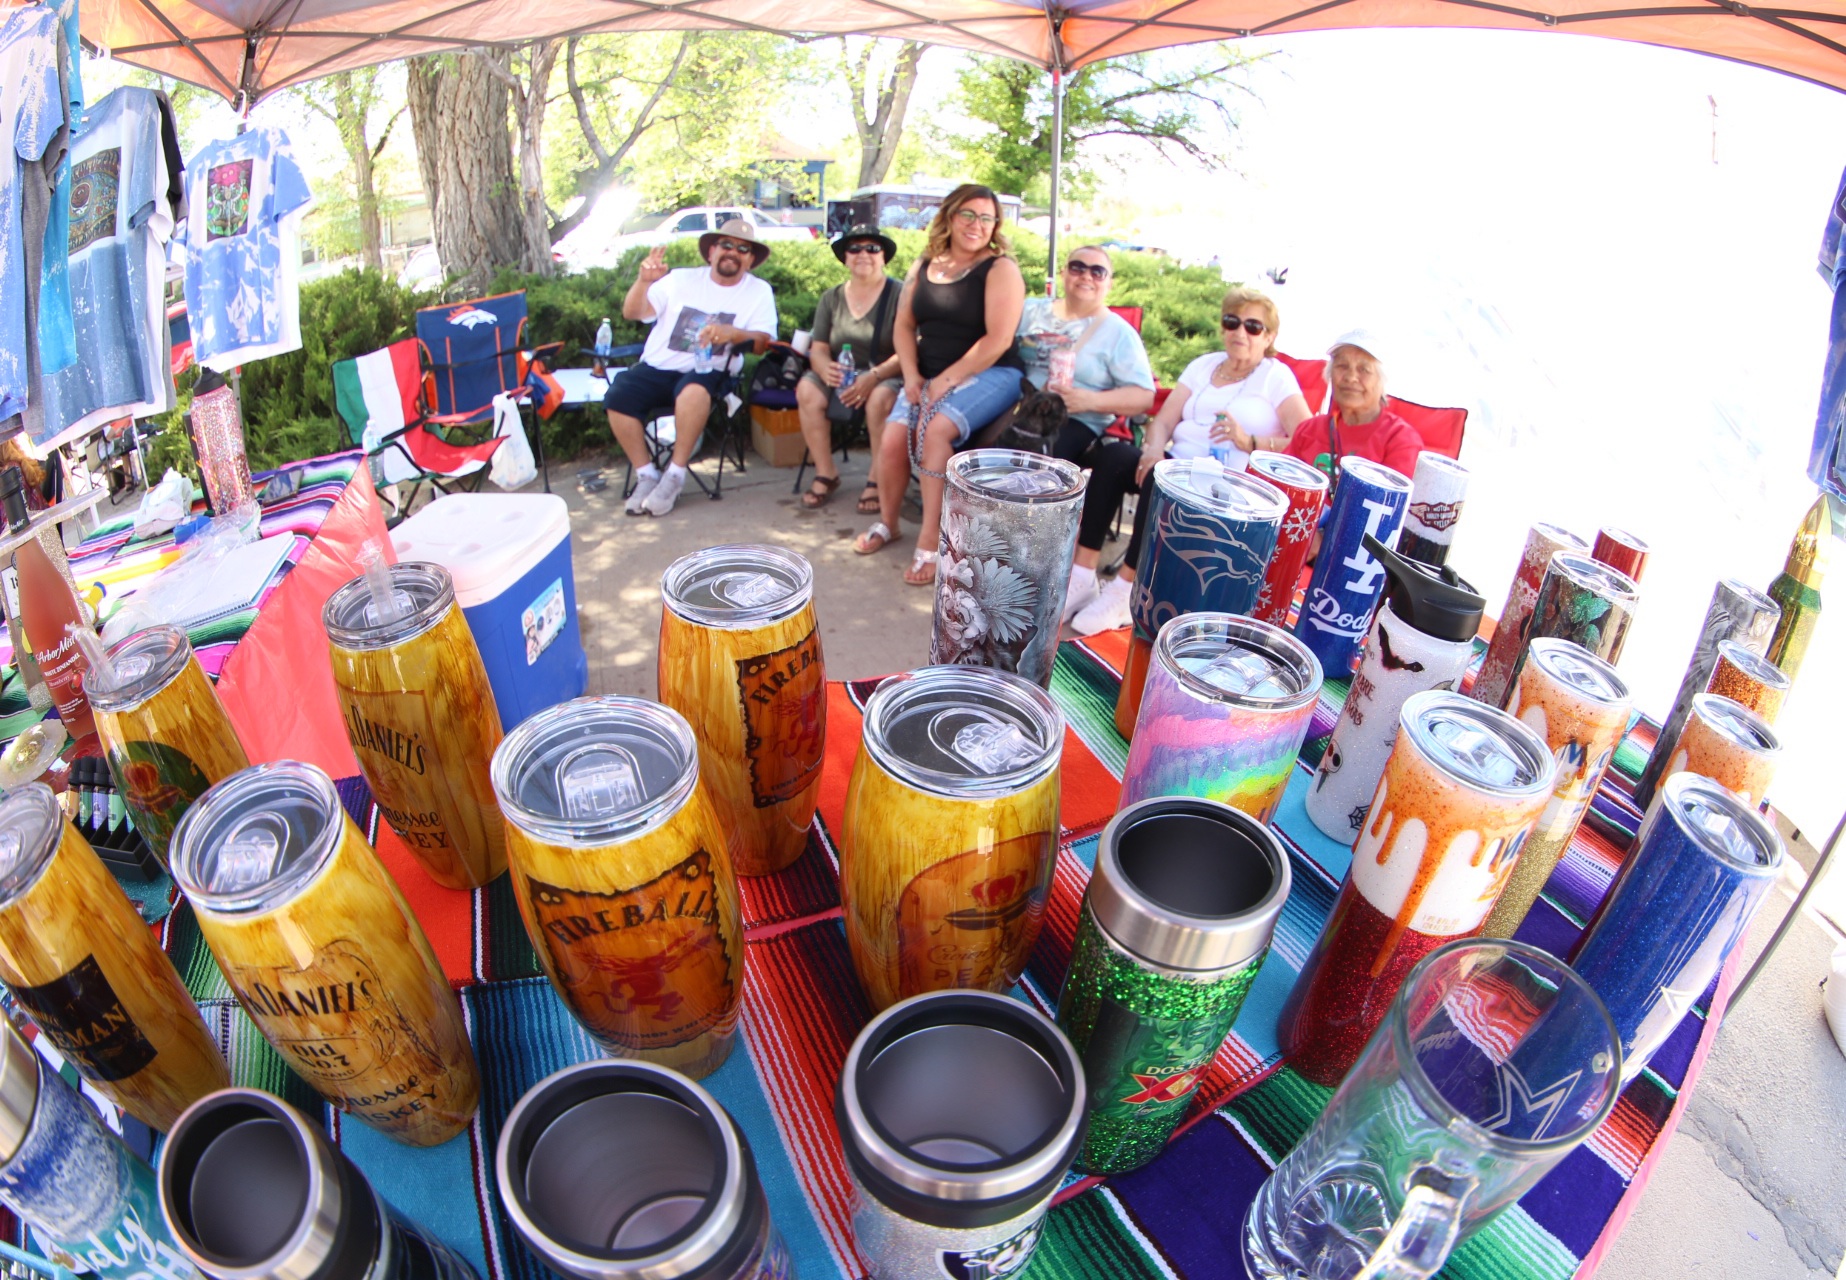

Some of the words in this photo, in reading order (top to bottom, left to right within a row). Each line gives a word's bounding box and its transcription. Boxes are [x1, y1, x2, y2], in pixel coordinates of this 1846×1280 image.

[750, 644, 820, 705] FIREBA
[350, 704, 427, 776] DANIEL'S
[546, 889, 714, 946] FIREBALL
[253, 970, 375, 1018] DANIEL'S
[290, 1043, 338, 1059] Old
[1146, 1064, 1185, 1076] DOS
